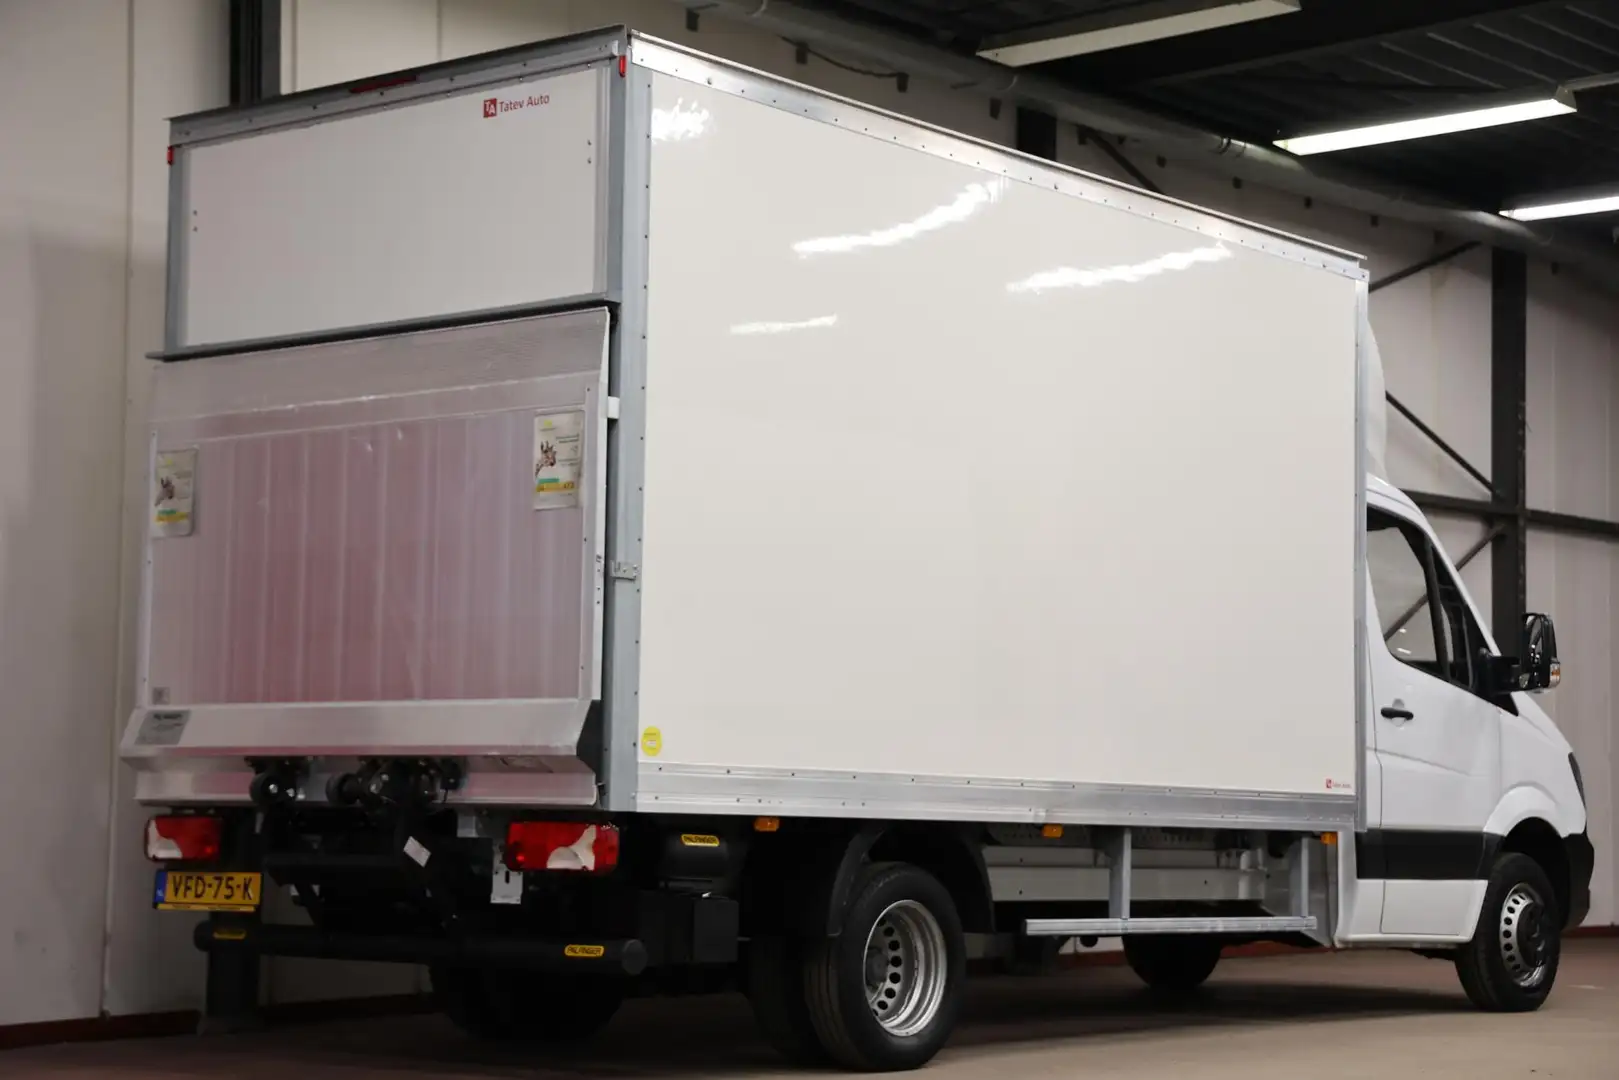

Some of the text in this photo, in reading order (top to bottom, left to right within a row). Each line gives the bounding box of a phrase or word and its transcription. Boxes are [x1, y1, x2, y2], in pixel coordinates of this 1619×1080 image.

[499, 100, 524, 113] Tatev
[526, 95, 550, 108] Auto
[172, 875, 253, 901] VFD-75-K
